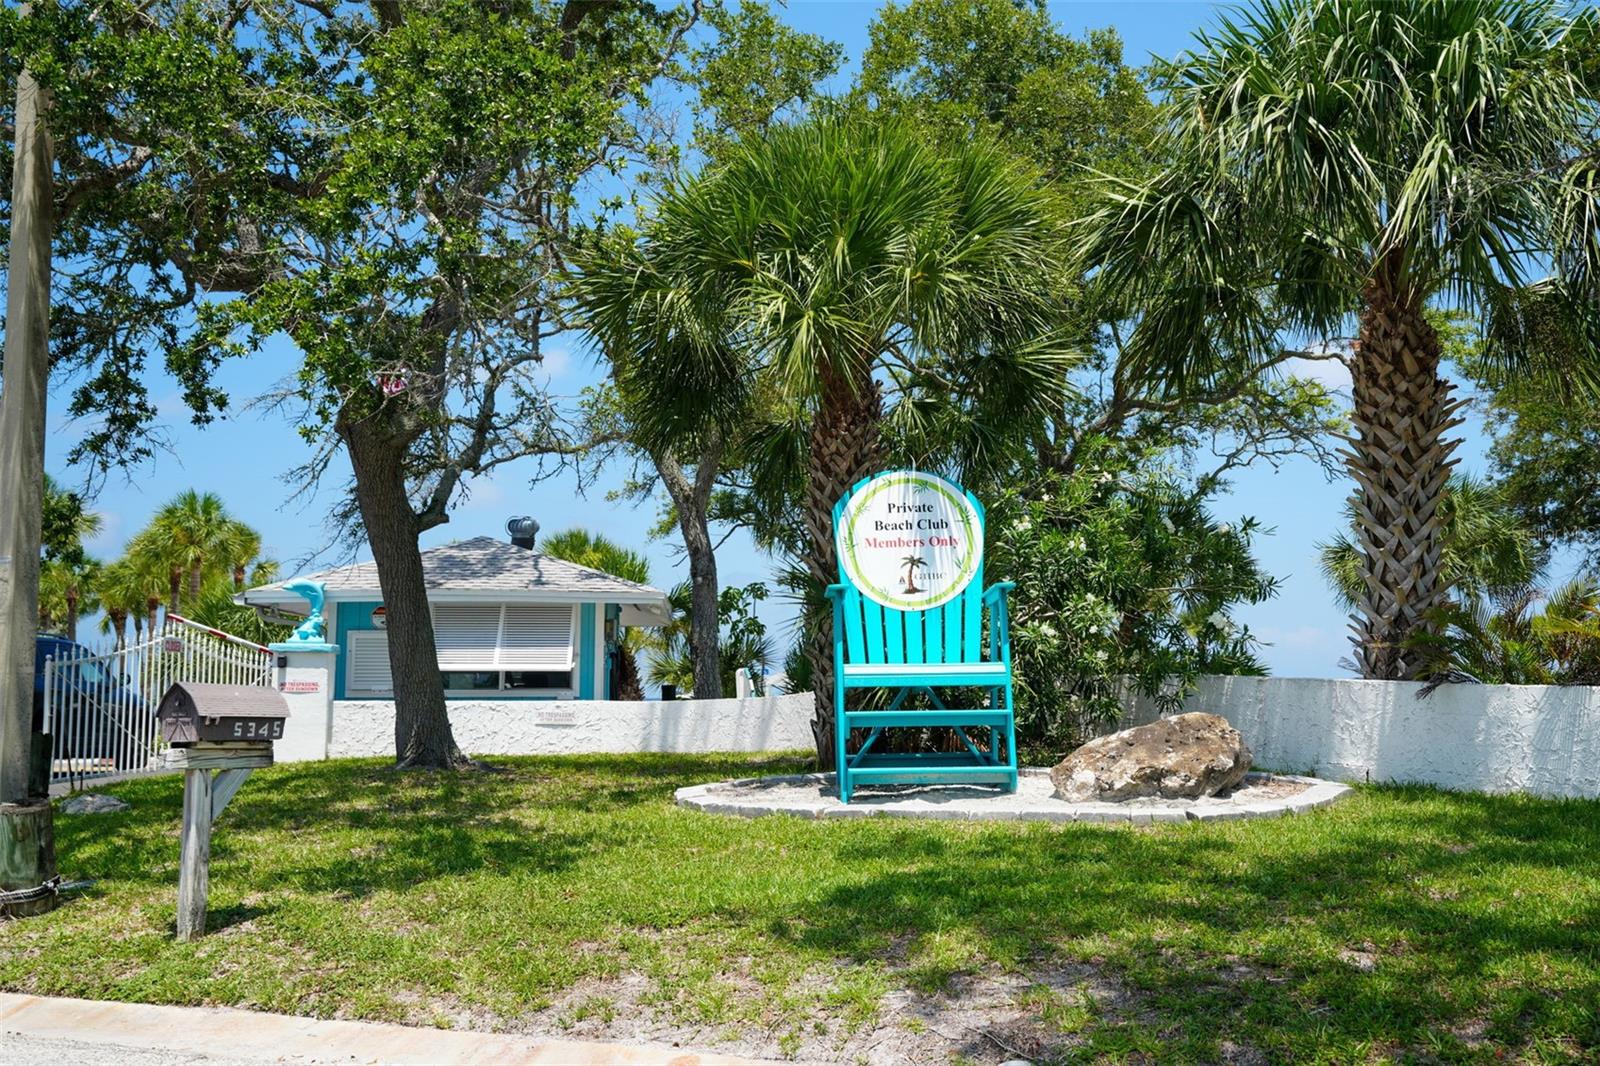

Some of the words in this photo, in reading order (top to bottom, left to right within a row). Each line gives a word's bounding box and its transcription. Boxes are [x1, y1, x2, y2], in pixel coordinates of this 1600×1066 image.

[887, 502, 934, 514] Private
[874, 519, 913, 531] Beach
[917, 518, 949, 531] Club
[864, 537, 925, 549] Members
[928, 535, 960, 550] Only
[233, 721, 281, 737] 5345
